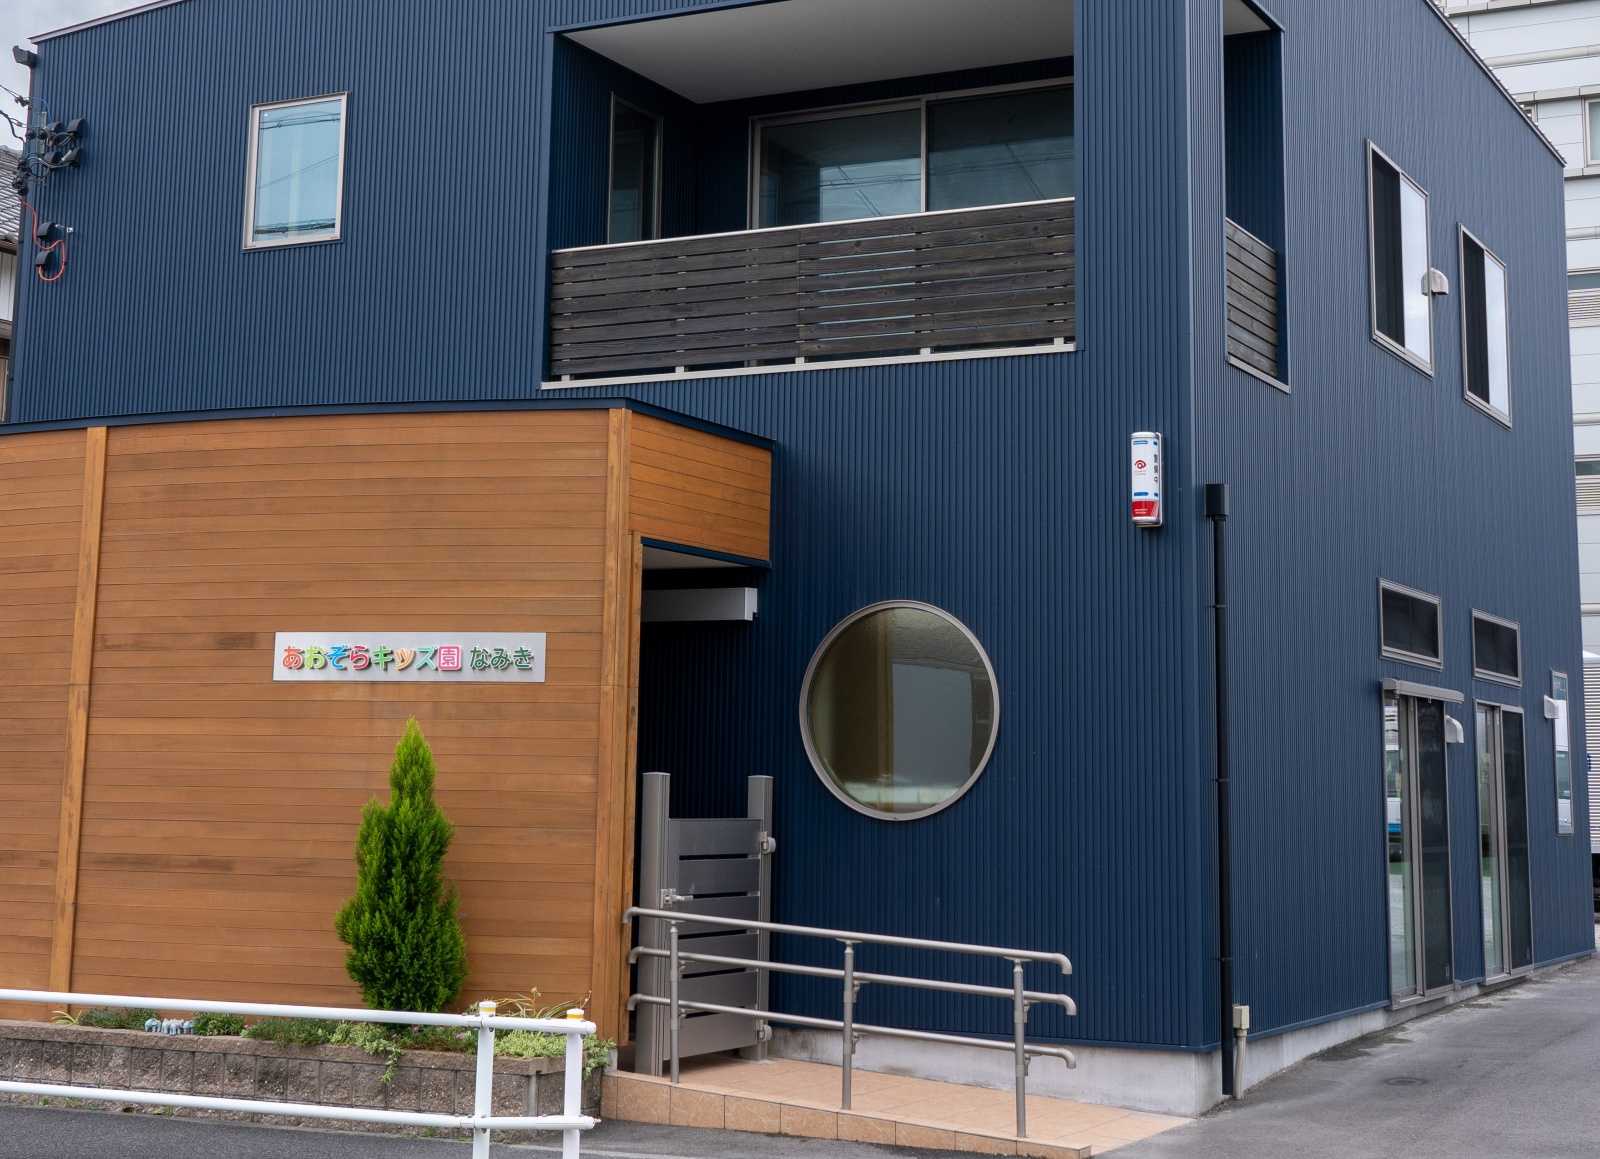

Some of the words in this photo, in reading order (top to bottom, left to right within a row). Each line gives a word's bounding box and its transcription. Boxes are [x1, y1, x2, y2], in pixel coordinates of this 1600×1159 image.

[282, 645, 462, 671] あおぞらキッズ園
[470, 646, 533, 670] なみき
